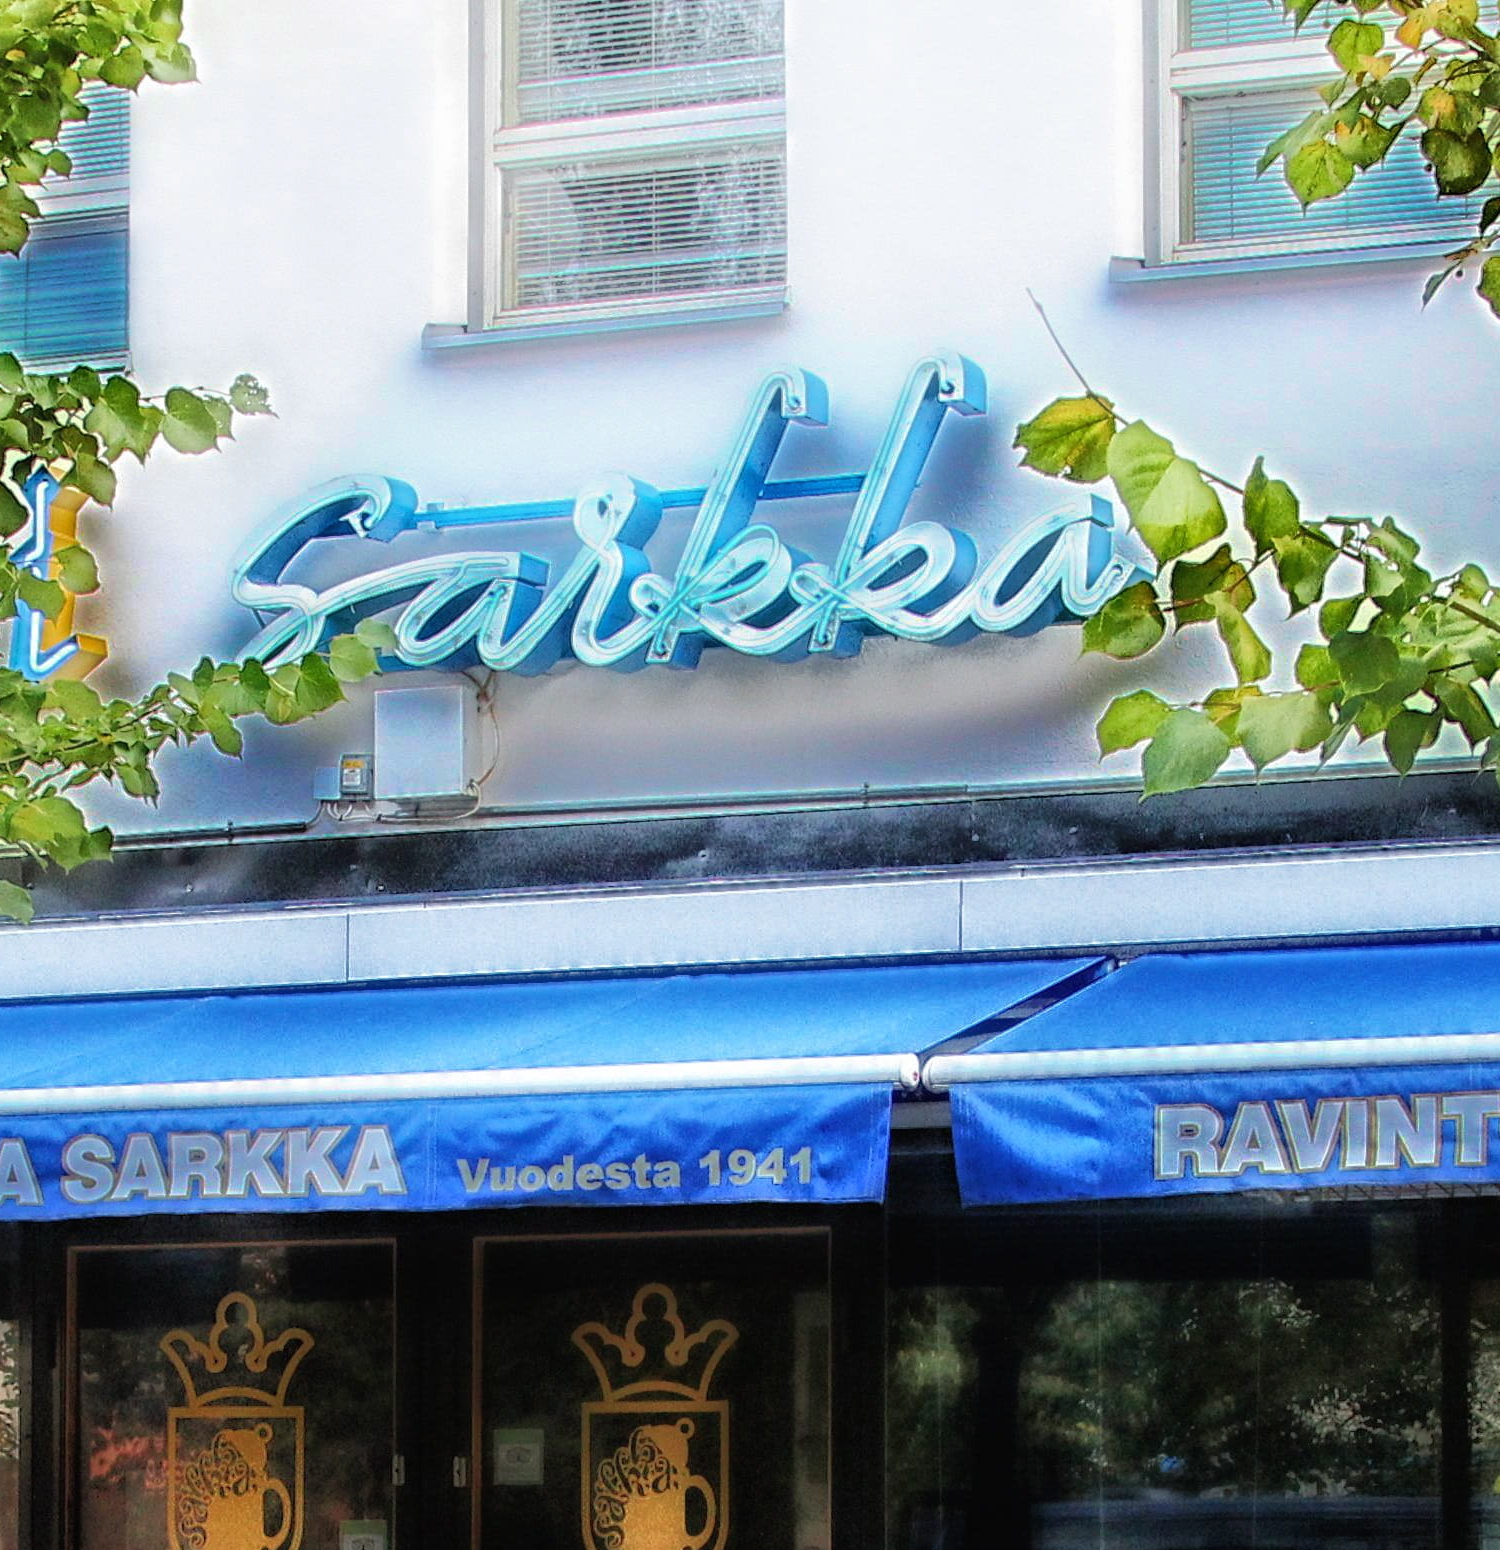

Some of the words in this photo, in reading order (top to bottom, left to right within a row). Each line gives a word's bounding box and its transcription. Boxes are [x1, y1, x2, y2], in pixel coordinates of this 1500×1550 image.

[60, 1124, 407, 1202] SARKKA
[456, 1154, 681, 1193] Vuodesta
[699, 1147, 813, 1186] 1941
